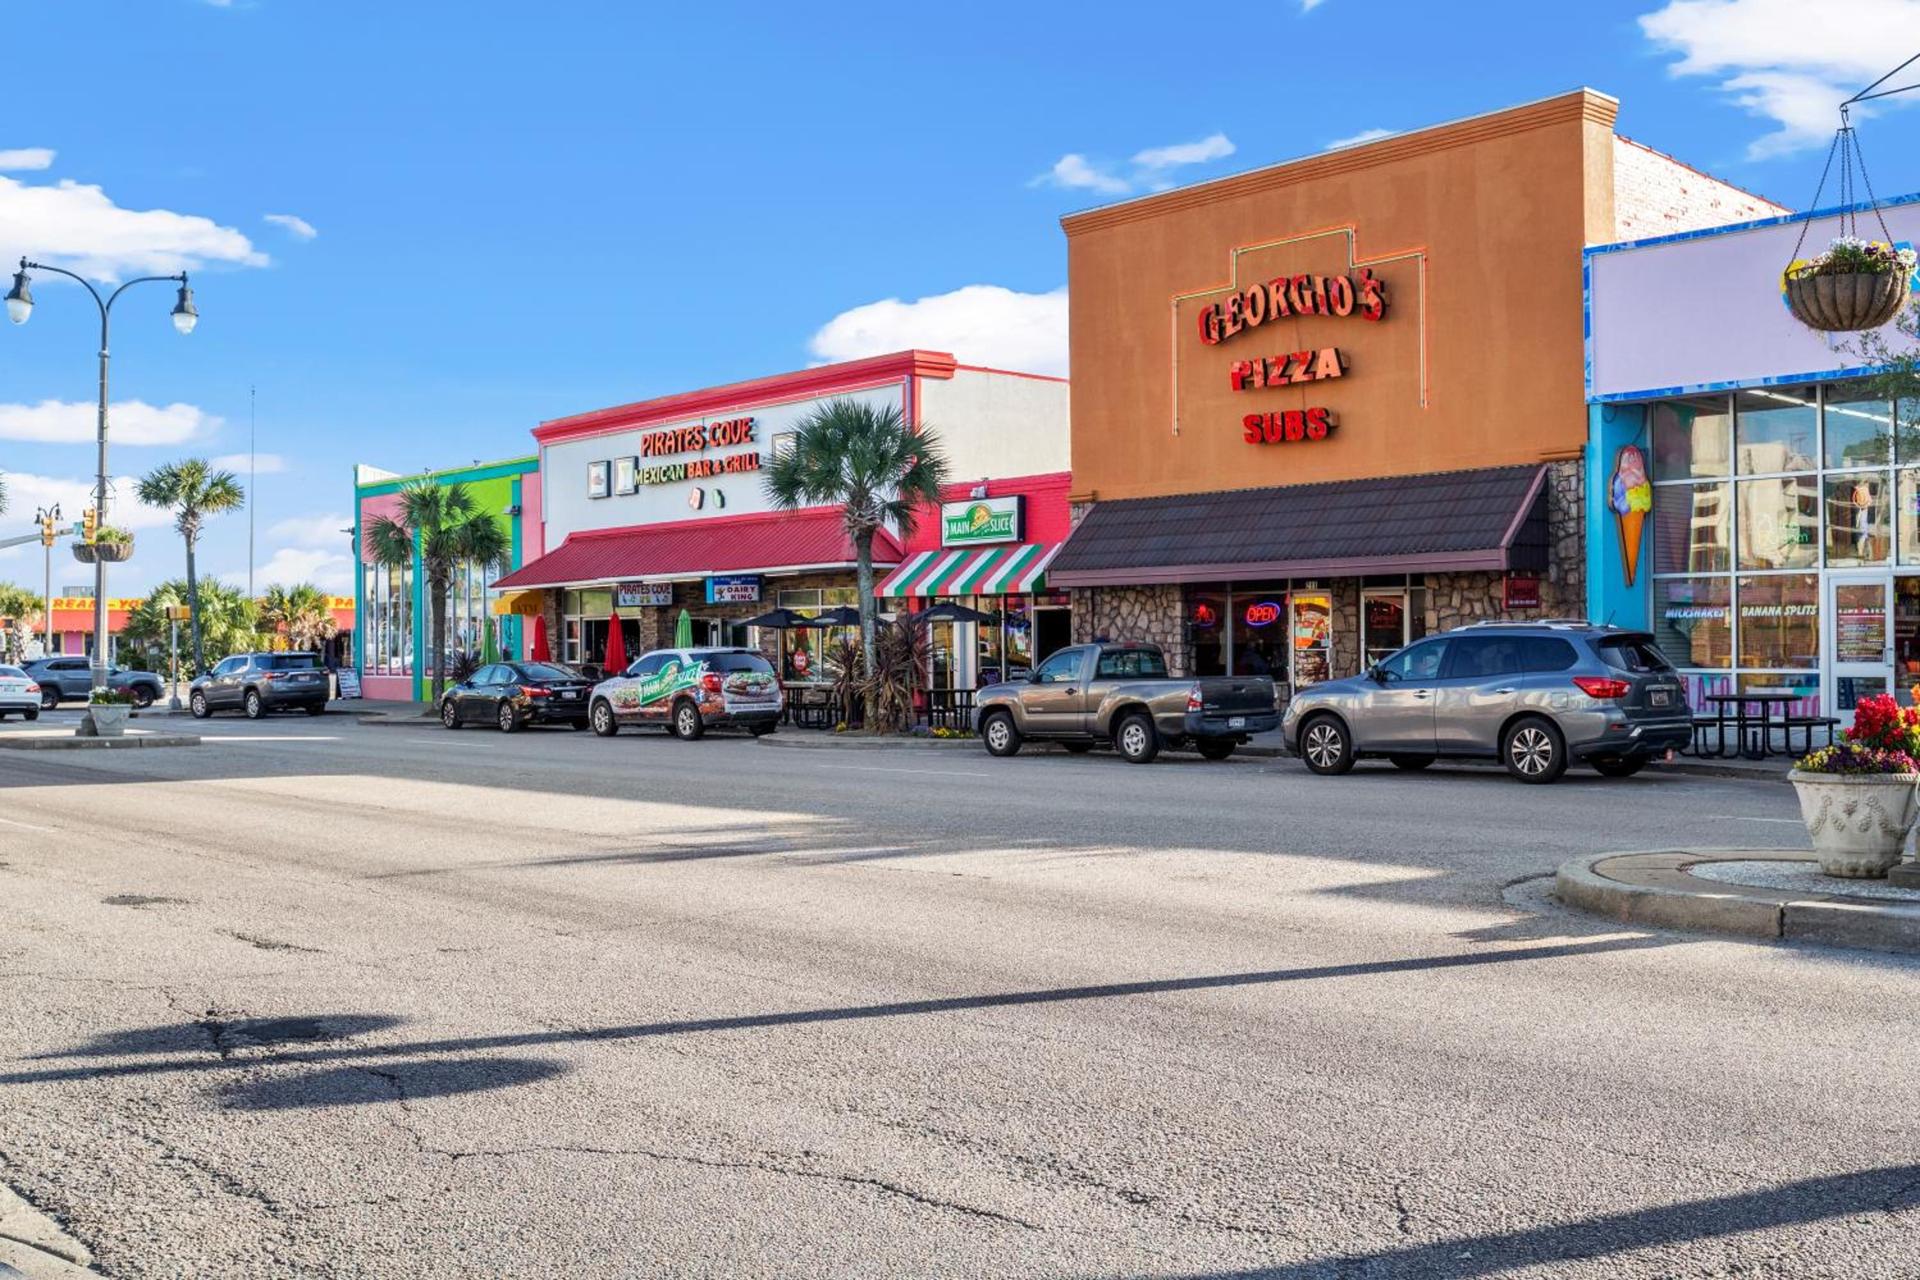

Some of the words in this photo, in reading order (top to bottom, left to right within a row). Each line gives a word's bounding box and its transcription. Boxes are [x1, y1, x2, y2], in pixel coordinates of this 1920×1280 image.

[1198, 268, 1387, 346] GEORGIO'S
[1231, 347, 1344, 392] PIZZA
[641, 425, 706, 457] PIRATES
[709, 417, 754, 447] COVE
[1243, 407, 1331, 444] SUBS
[634, 463, 685, 485] MEXICAN
[687, 459, 714, 478] BAR
[724, 452, 760, 473] GRILL
[950, 521, 970, 535] MAIN
[990, 517, 1010, 532] SLICE
[619, 583, 651, 595] PIRATES
[652, 583, 671, 594] COVE
[731, 593, 753, 601] KING
[1248, 606, 1277, 621] OPEN
[1665, 607, 1725, 618] MILKSHAKES
[1741, 606, 1782, 617] BANANA
[1783, 604, 1818, 616] SPLITS
